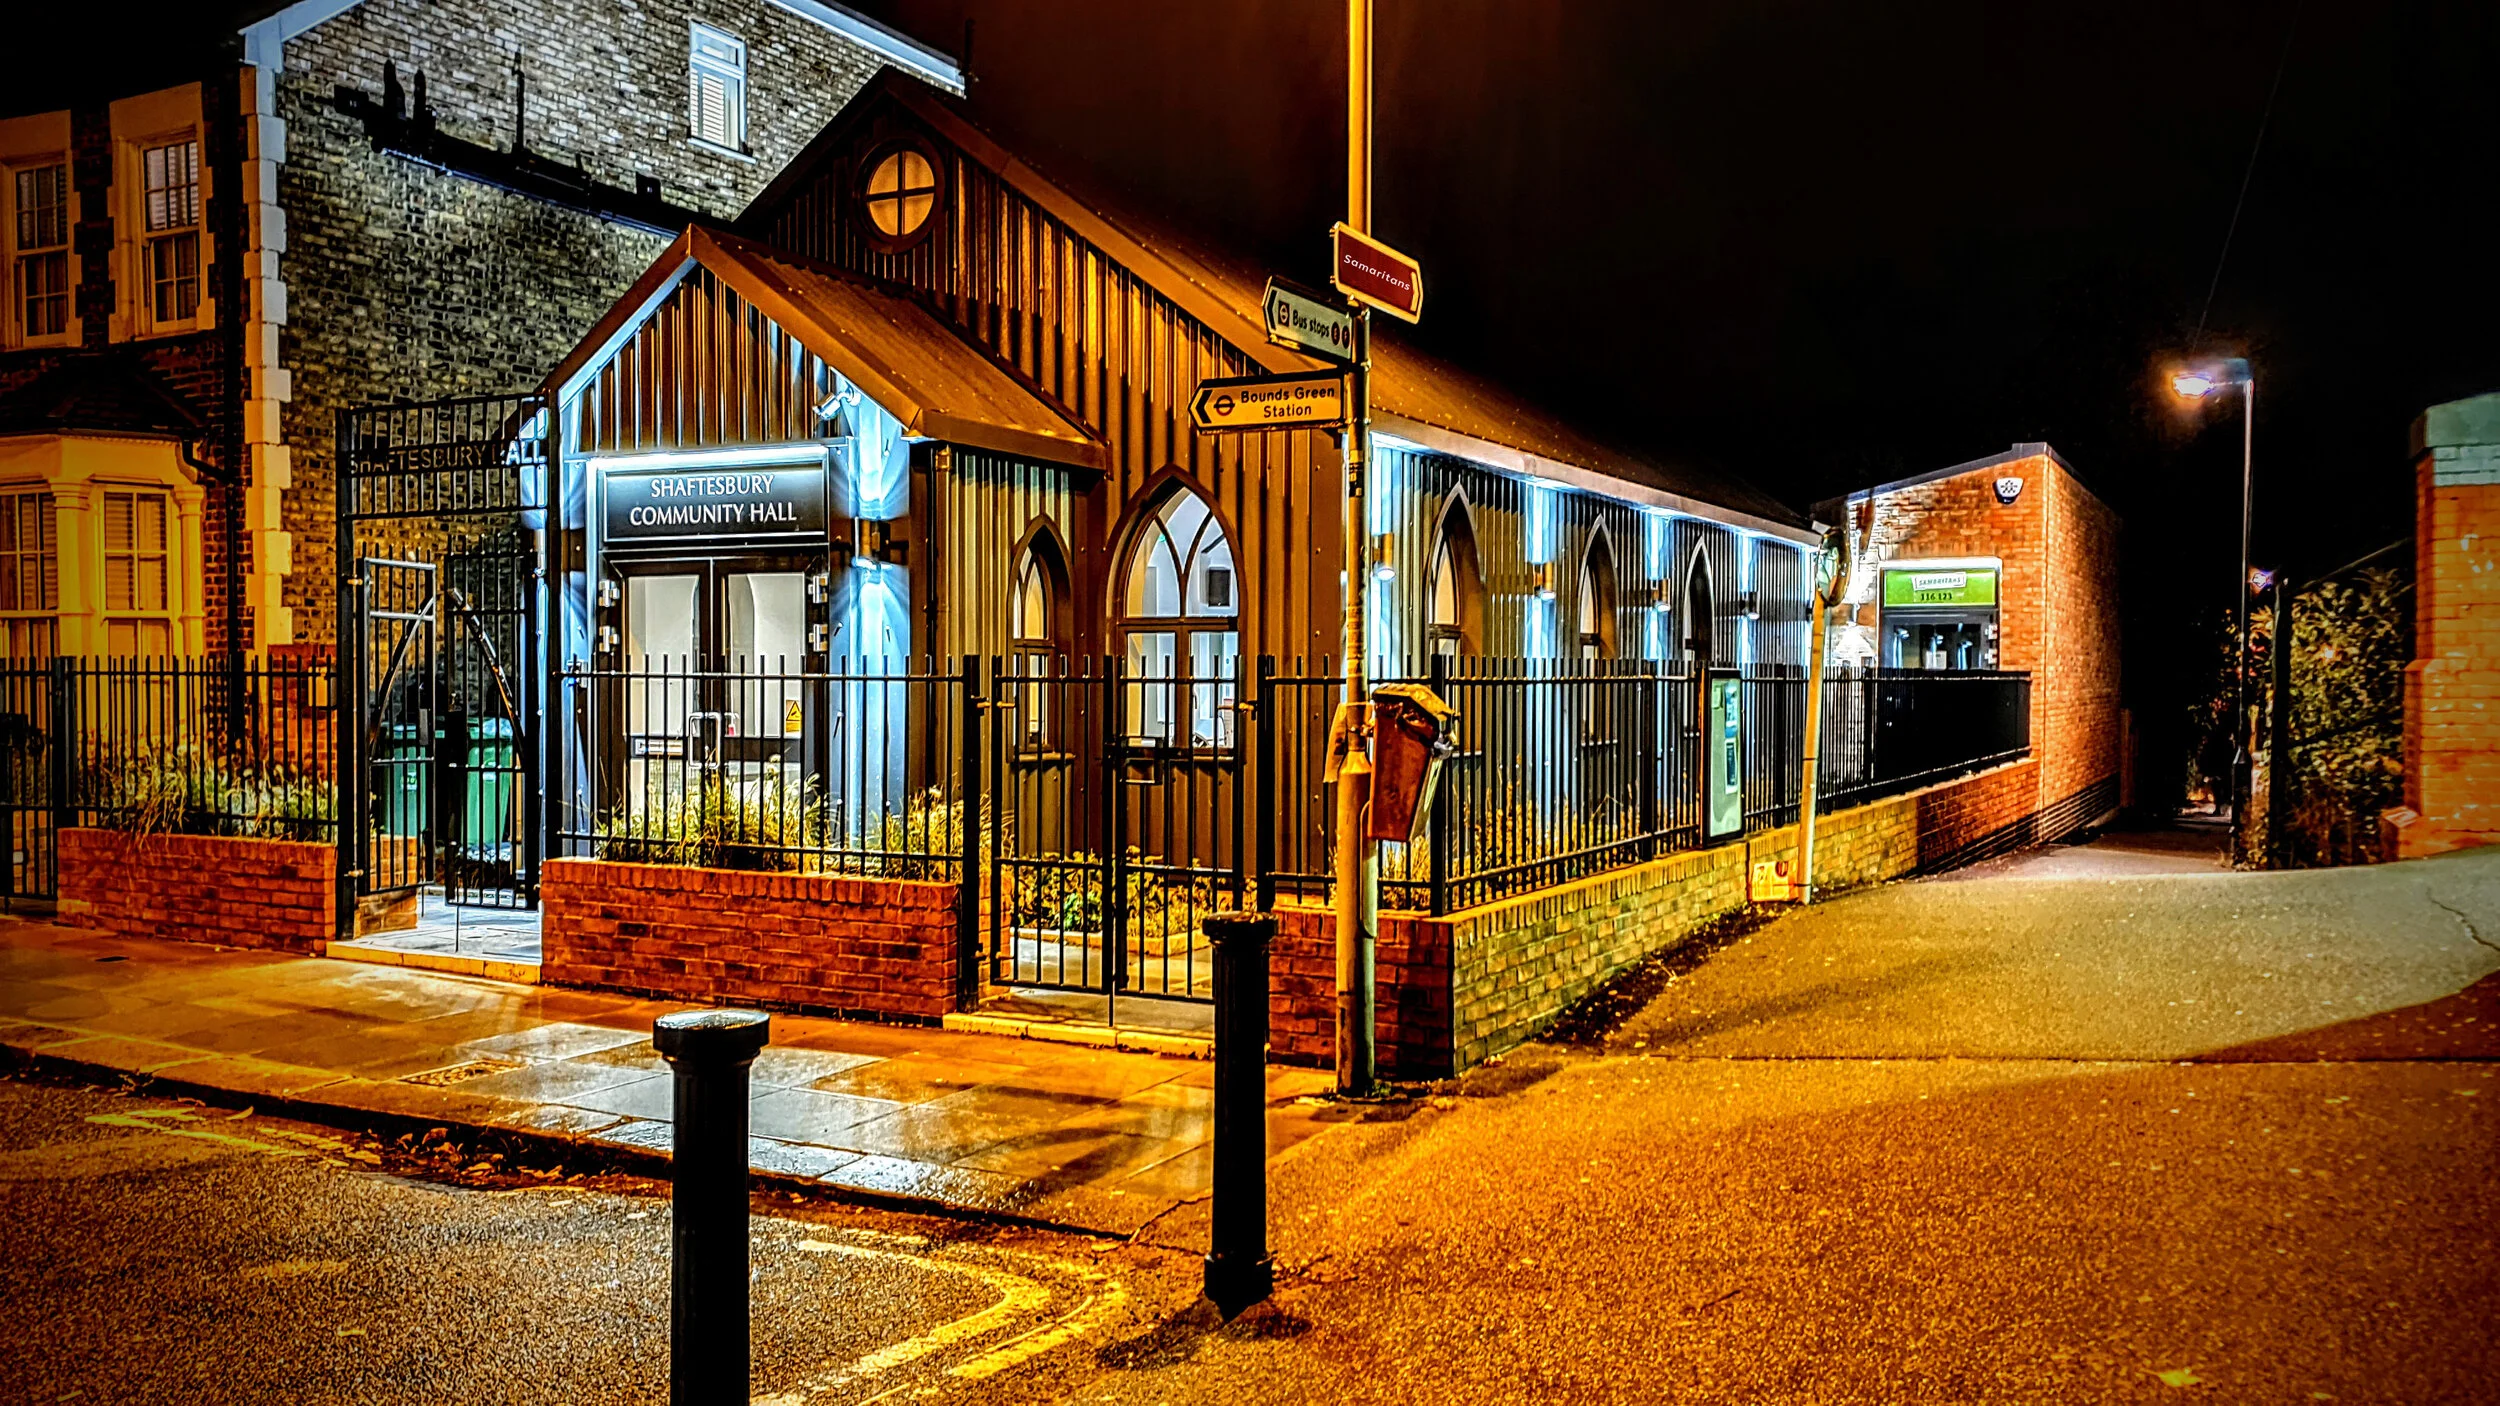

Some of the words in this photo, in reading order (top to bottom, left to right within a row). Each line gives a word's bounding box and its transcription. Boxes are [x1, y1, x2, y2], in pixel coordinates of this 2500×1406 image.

[1344, 254, 1410, 291] Samaritans
[1292, 311, 1308, 329] Bus
[1309, 316, 1330, 338] stops
[1241, 388, 1290, 403] Bounds
[1295, 386, 1335, 399] Green
[1263, 401, 1312, 418] Station
[651, 474, 774, 498] SHAFTESBURY
[629, 503, 744, 526] COMMUNITY
[750, 501, 798, 523] HALL
